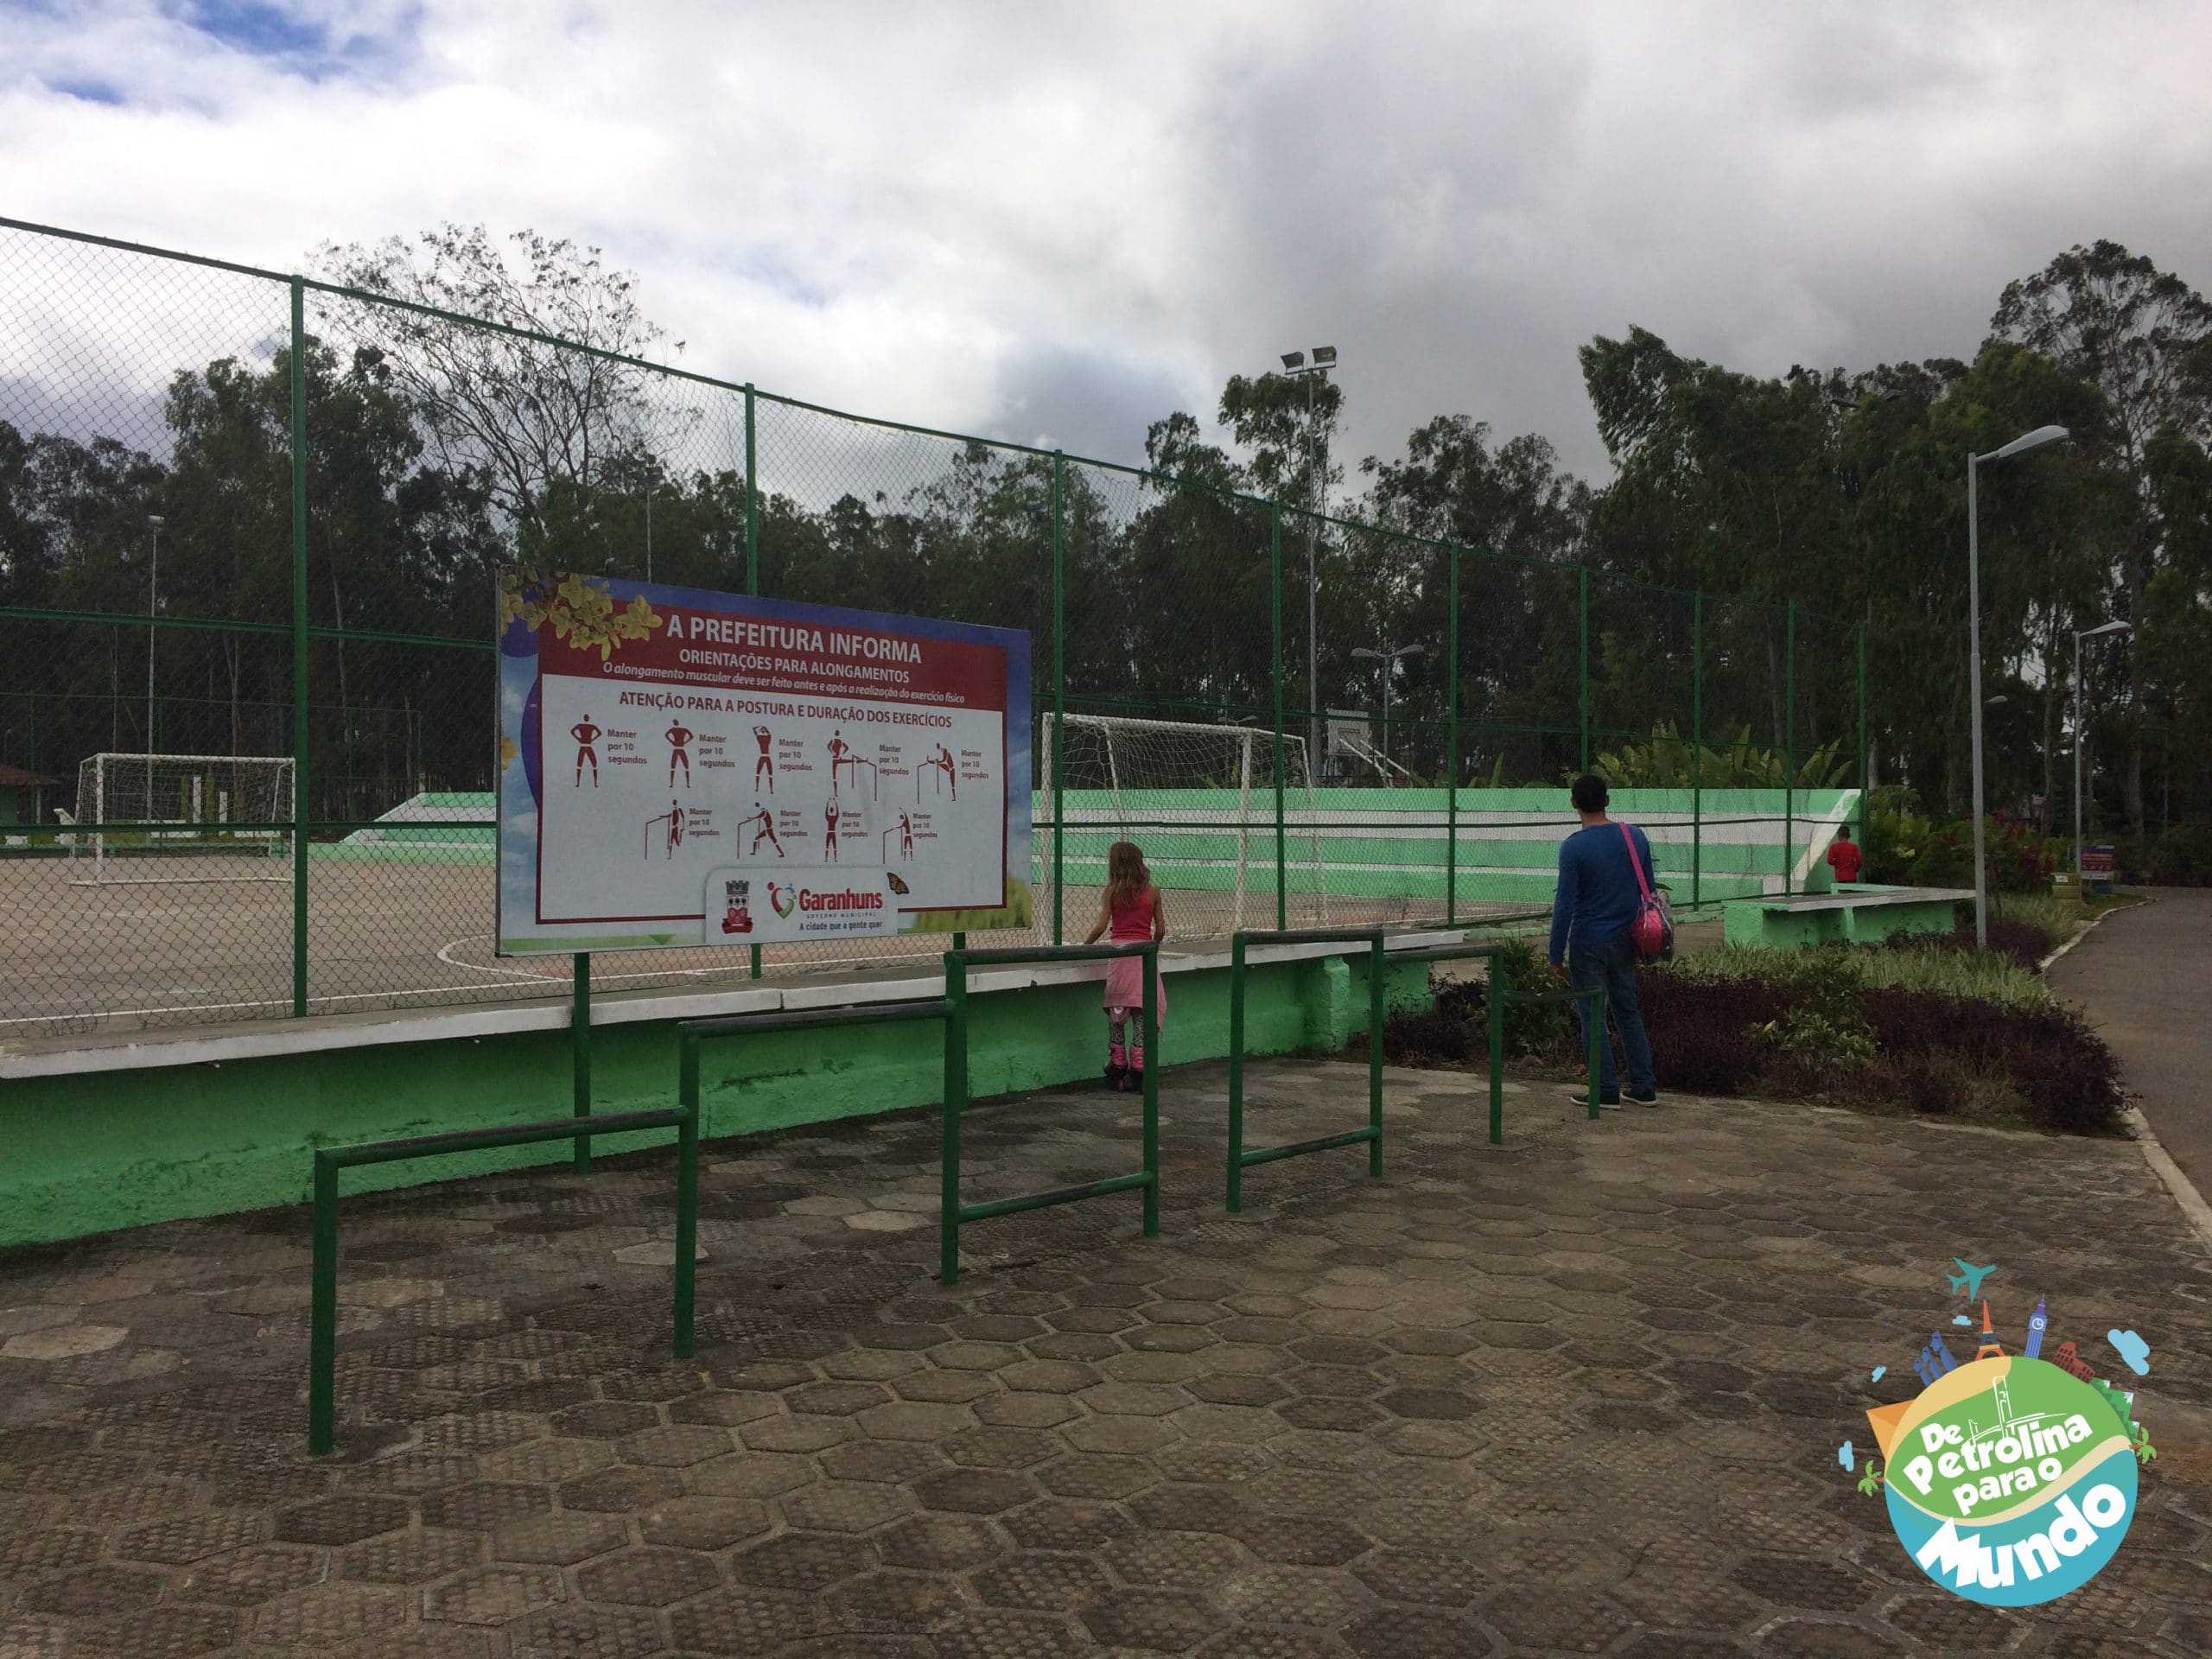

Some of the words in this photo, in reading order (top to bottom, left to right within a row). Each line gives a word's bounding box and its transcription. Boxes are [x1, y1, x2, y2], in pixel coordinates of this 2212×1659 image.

[666, 614, 684, 639] A
[690, 616, 824, 652] PREFEITURA
[830, 632, 922, 664] INFORMA
[679, 649, 772, 671] ORIENTAÇÕES
[775, 658, 808, 674] PARA
[810, 661, 910, 683] ALONGAMENTOS
[603, 662, 613, 673] O
[614, 663, 684, 678] alongamento
[686, 671, 731, 683] muscular
[732, 673, 755, 685] deve
[756, 677, 770, 687] ser
[772, 676, 792, 688] feito
[793, 680, 818, 690] antes
[826, 682, 847, 694] após
[856, 684, 898, 698] realização
[899, 688, 910, 698] do
[911, 691, 944, 702] exercício
[945, 692, 965, 703] físico
[620, 691, 684, 711] ATENÇÃO
[688, 696, 722, 711] PARA
[725, 700, 734, 712] A
[737, 701, 794, 716] POSTURA
[798, 705, 804, 716] E
[807, 705, 864, 723] DURAÇÃO
[868, 709, 890, 723] DOS
[893, 712, 951, 728] EXERCÍCIOS
[607, 728, 637, 739] Manter
[699, 734, 726, 743] Manter
[779, 739, 804, 747] Manter
[879, 744, 901, 753] Manter
[961, 749, 982, 758] Manter
[607, 755, 647, 765] segundos
[699, 759, 735, 768] segundos
[779, 762, 812, 772] segundos
[879, 767, 909, 777] segundos
[961, 771, 989, 780] segundos
[689, 829, 719, 837] segundos
[779, 830, 808, 838] segundos
[842, 830, 868, 839] segundos
[798, 887, 883, 911] Garanhuns
[806, 922, 827, 931] cidade
[830, 922, 841, 931] que
[849, 921, 867, 931] gente
[868, 921, 883, 930] quer
